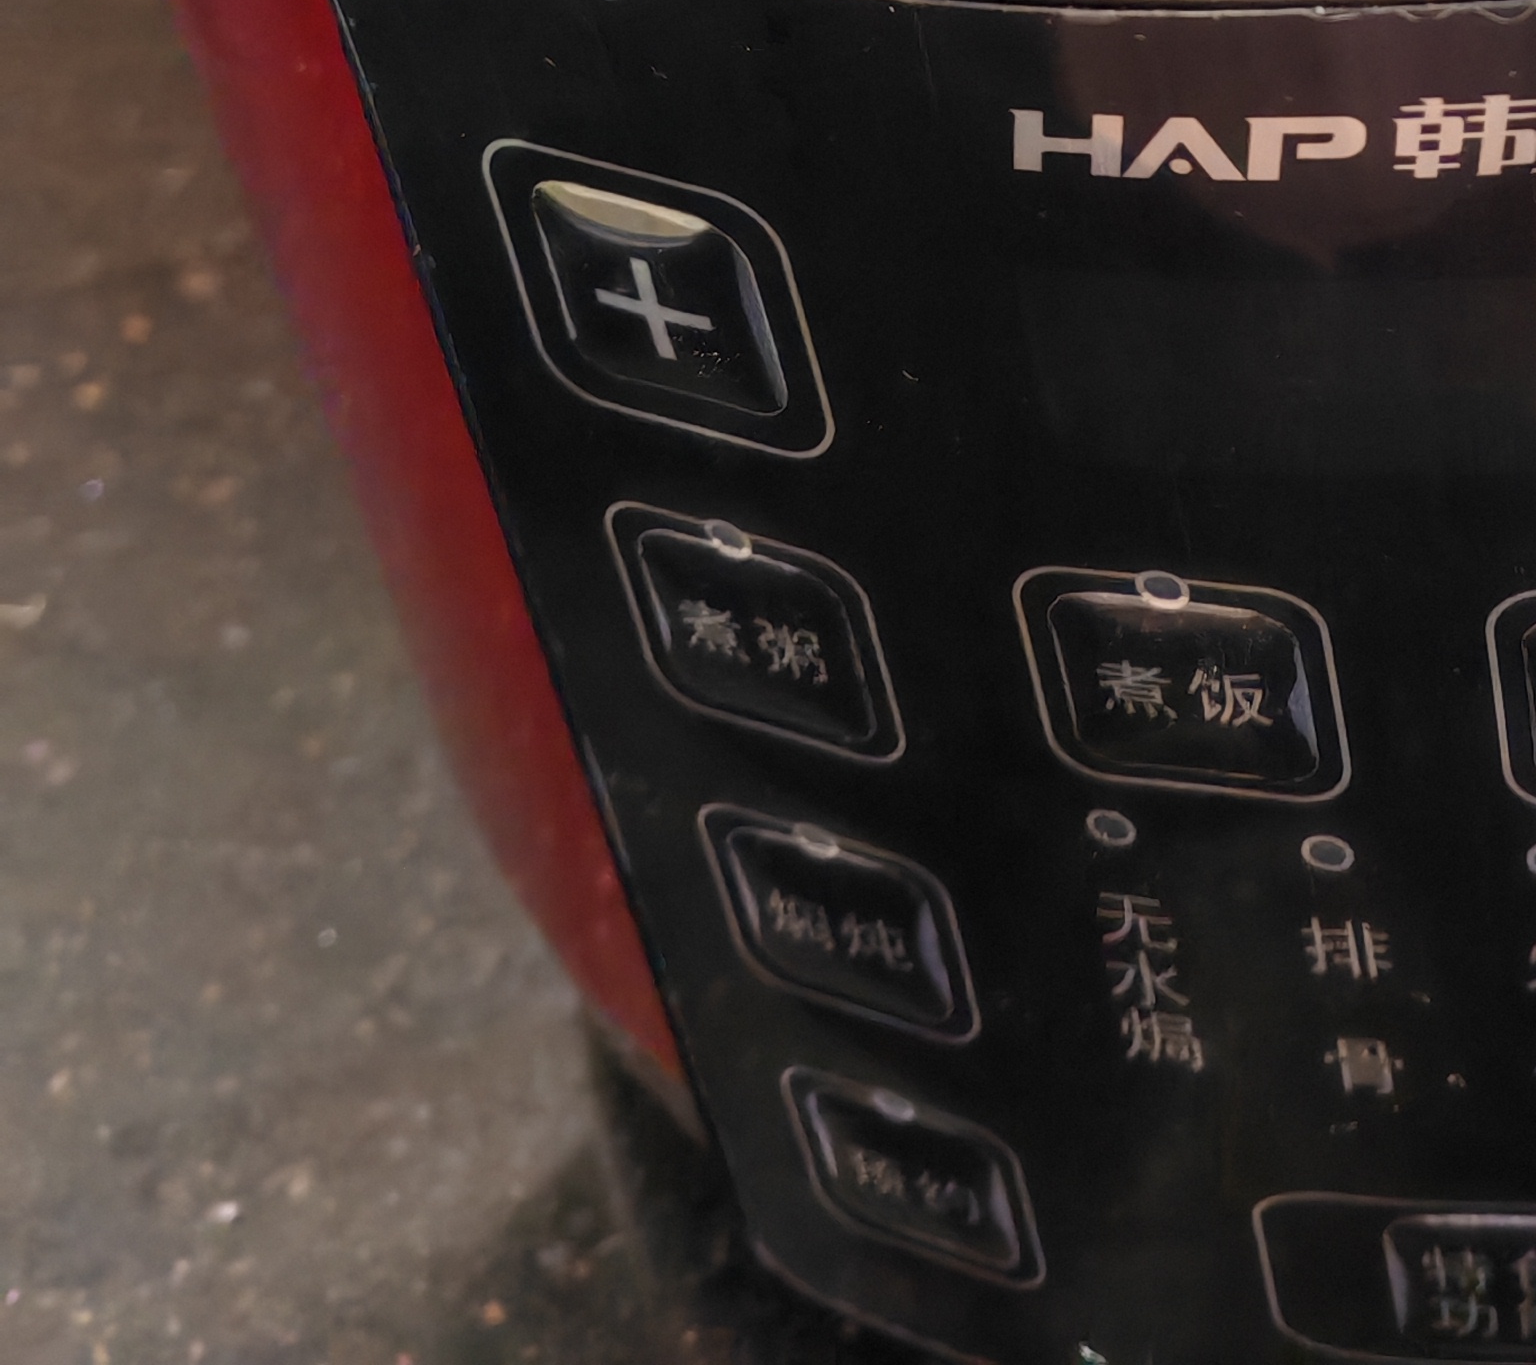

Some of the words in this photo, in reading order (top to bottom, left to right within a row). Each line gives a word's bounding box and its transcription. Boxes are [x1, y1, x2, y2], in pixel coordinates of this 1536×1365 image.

[1010, 109, 1368, 181] HAP
[676, 598, 829, 686] 煮粥
[1095, 657, 1274, 728] 煮饭
